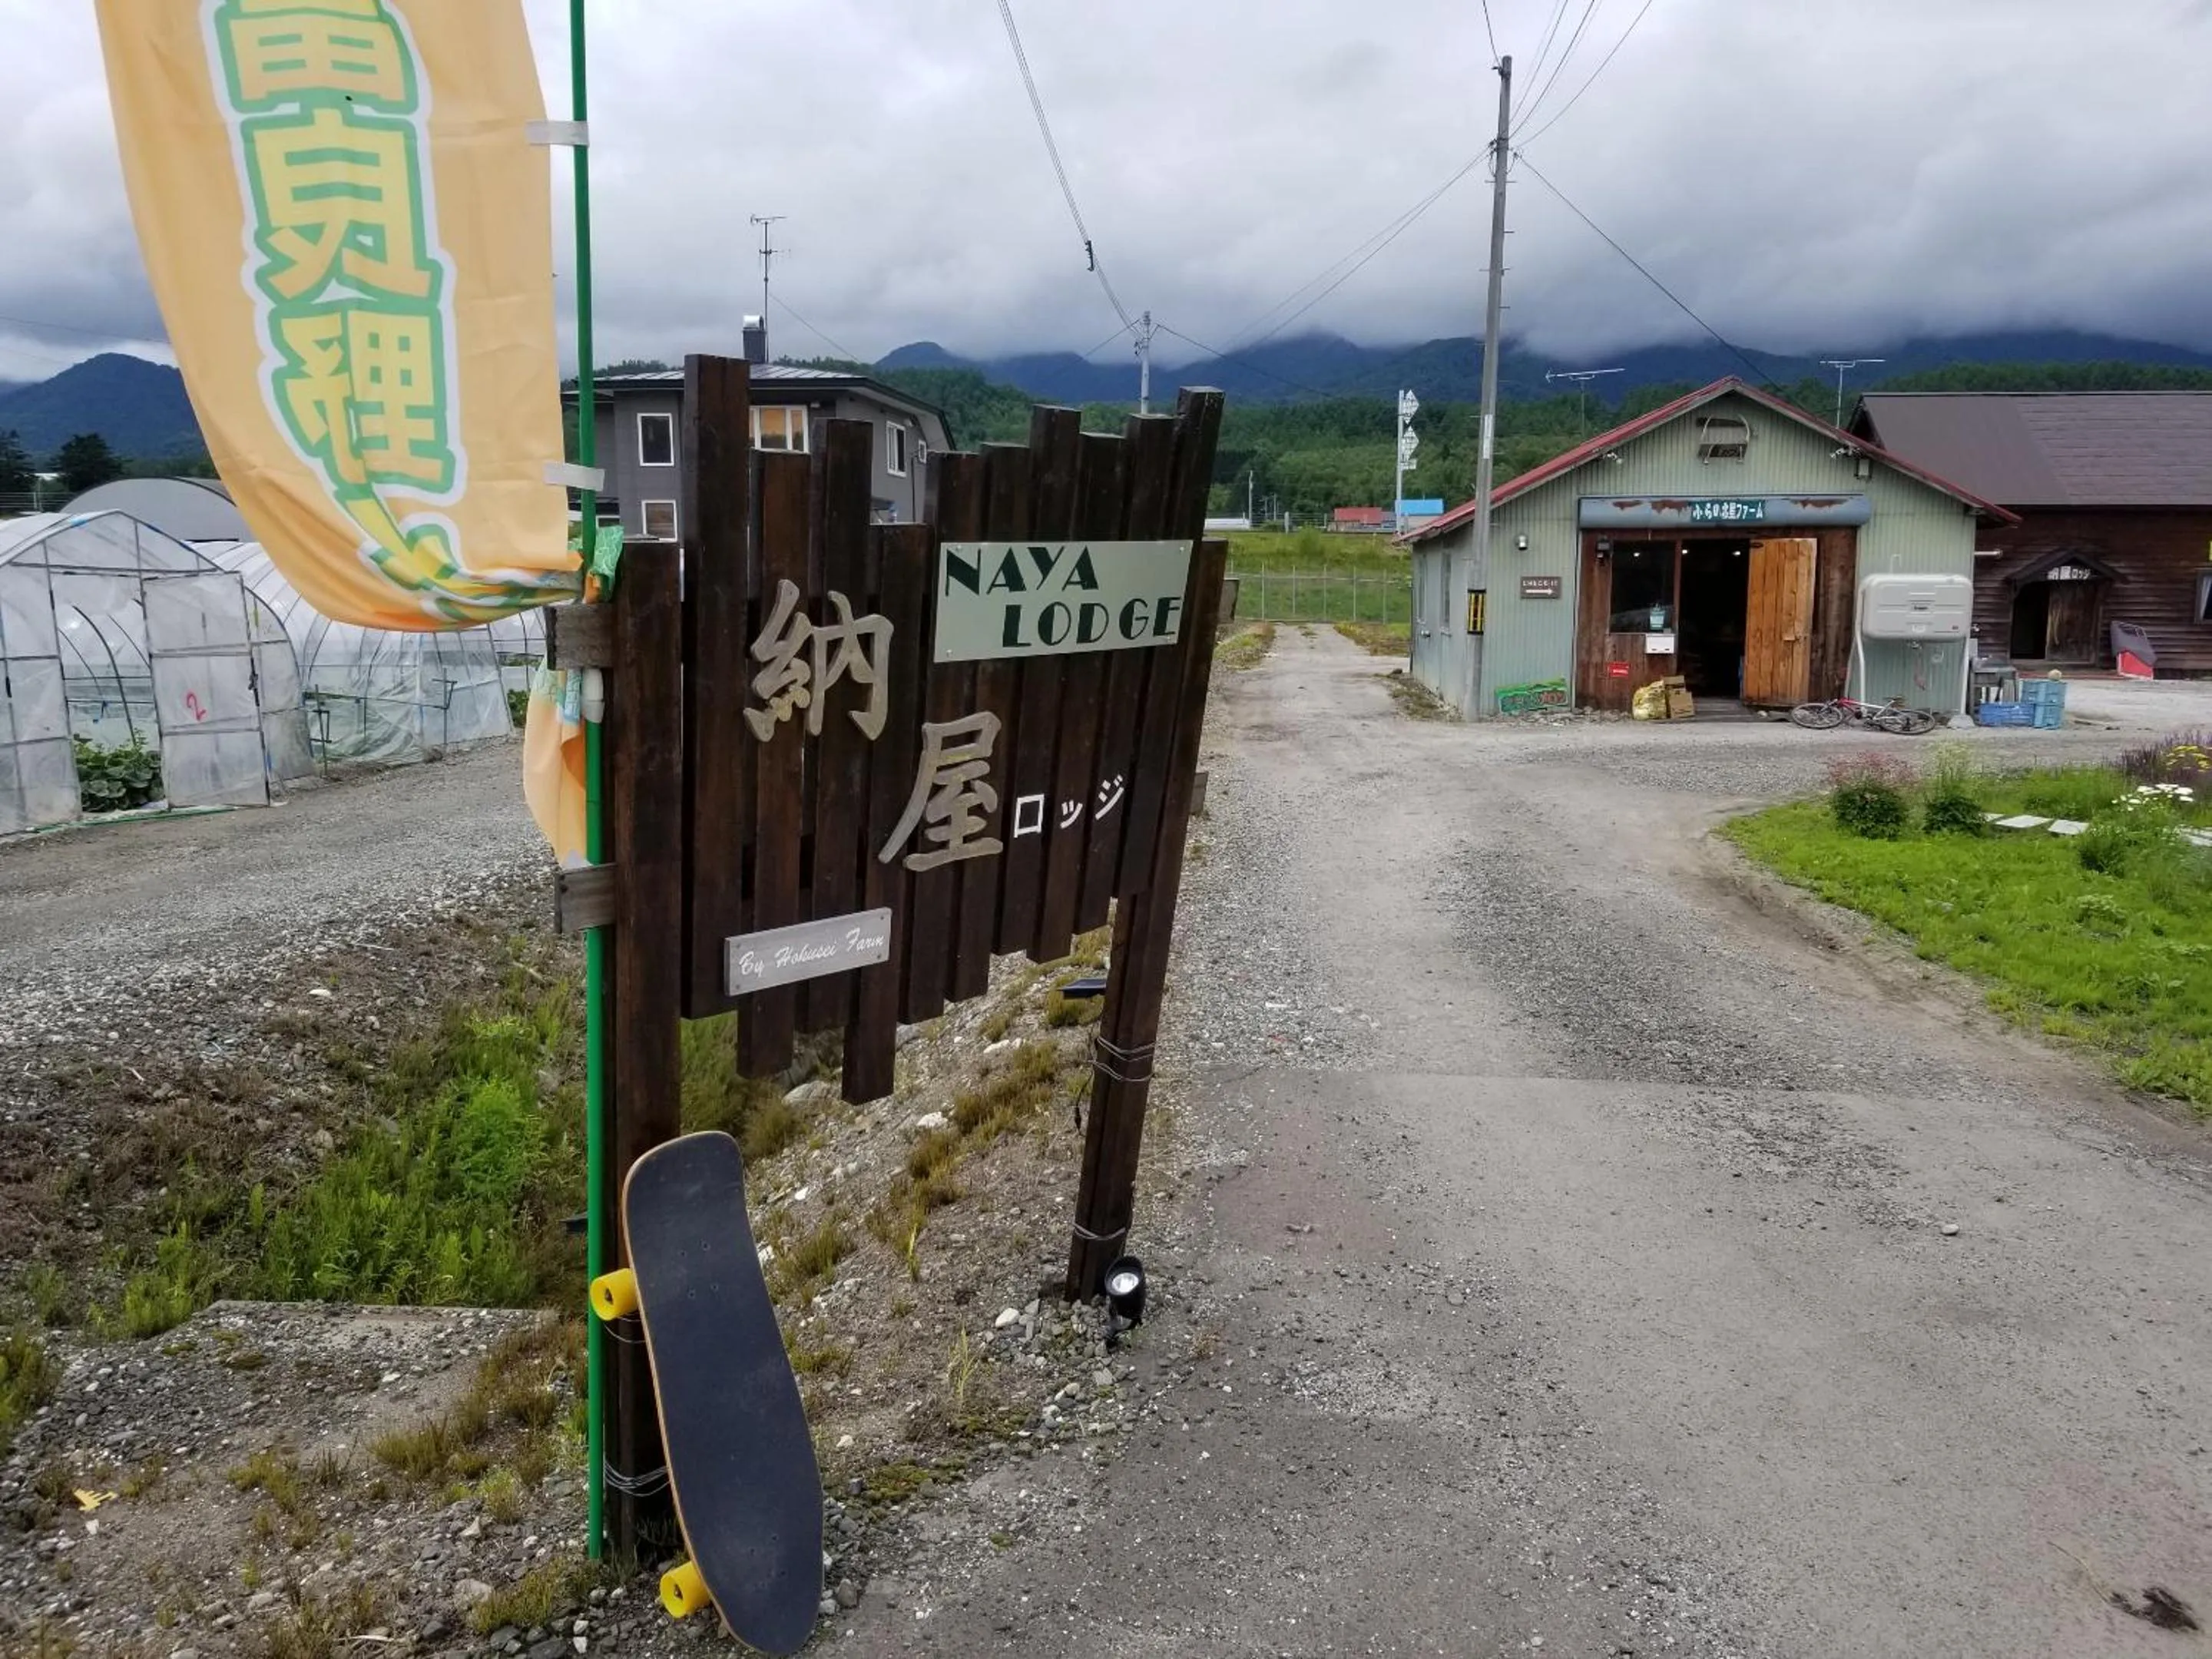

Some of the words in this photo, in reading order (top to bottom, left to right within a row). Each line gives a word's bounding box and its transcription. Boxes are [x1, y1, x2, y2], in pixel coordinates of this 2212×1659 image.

[945, 545, 1099, 596] NAYA
[1002, 597, 1181, 647] LODGE
[186, 692, 207, 721] 2
[739, 951, 765, 978] By
[845, 926, 884, 952] Farm
